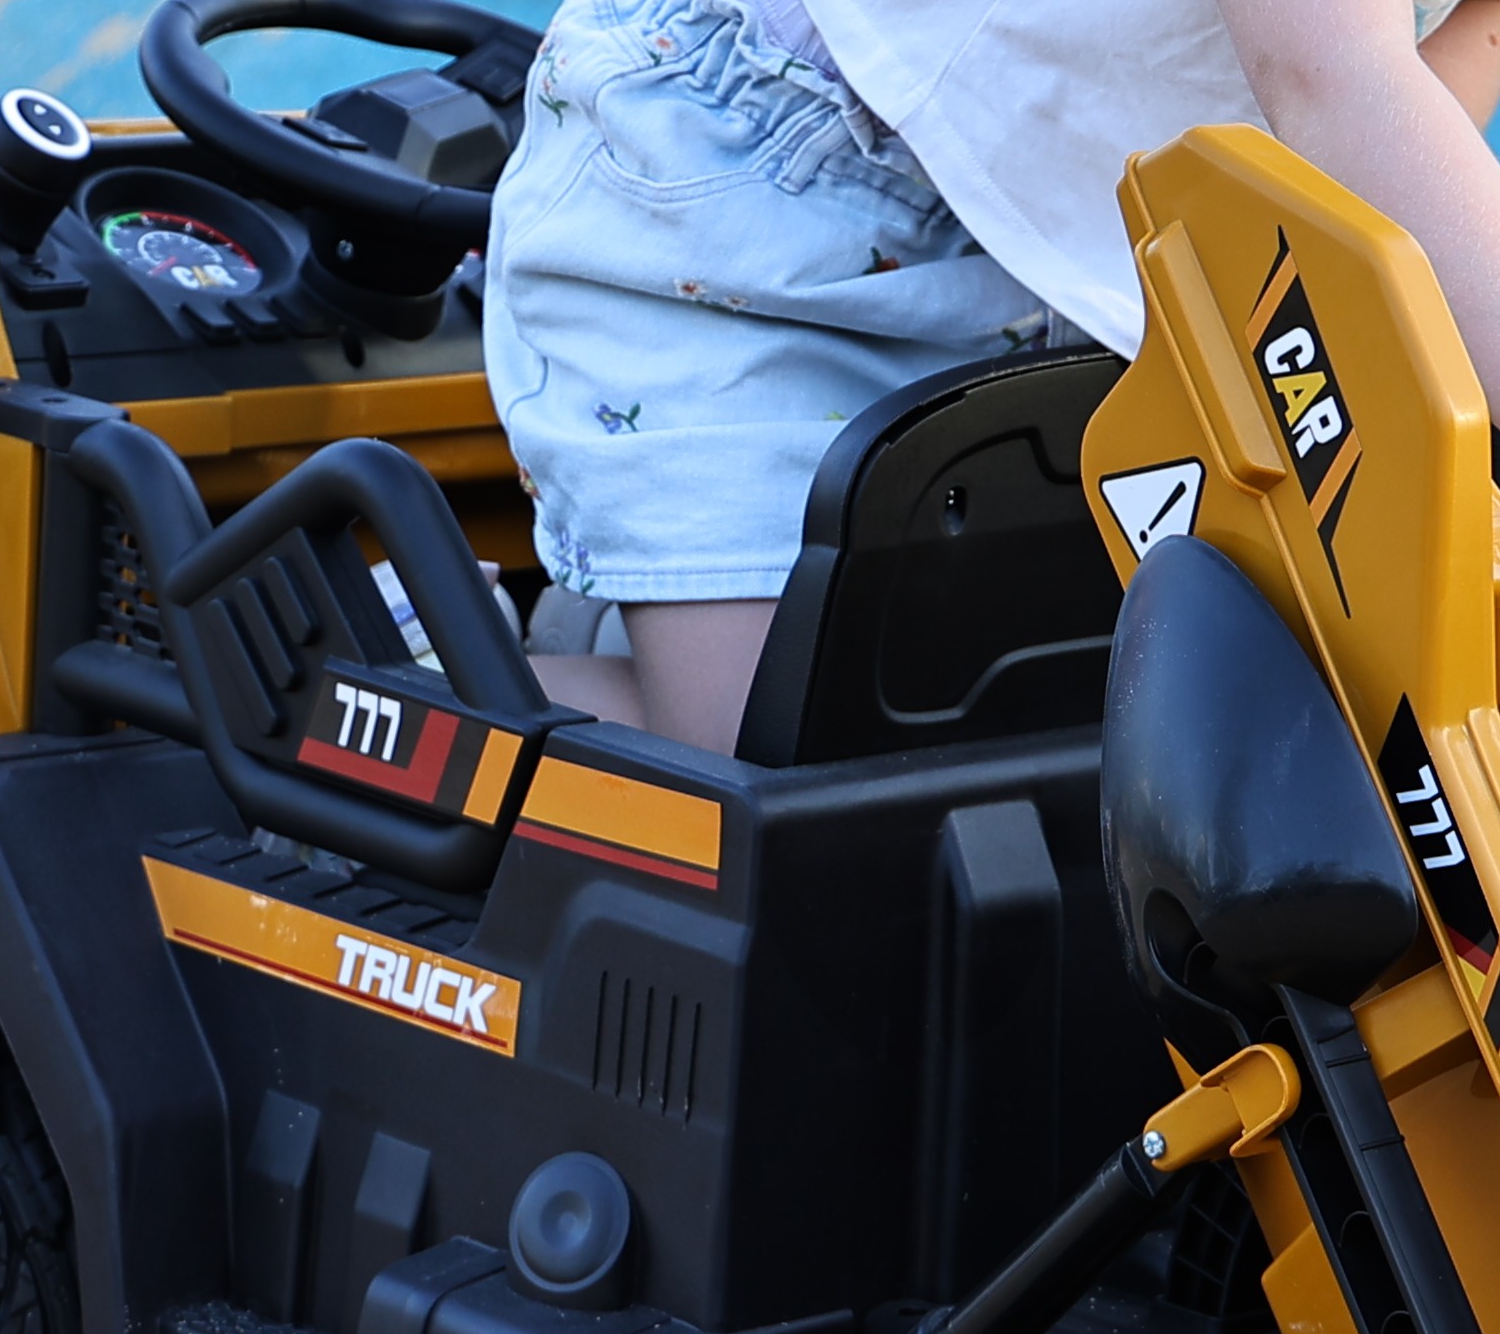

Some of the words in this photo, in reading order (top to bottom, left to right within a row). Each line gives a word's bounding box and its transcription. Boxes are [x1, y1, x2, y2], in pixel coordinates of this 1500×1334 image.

[1262, 325, 1343, 460] CAR
[333, 682, 402, 763] 777
[1395, 764, 1466, 870] 777
[334, 933, 497, 1035] TRUCK
